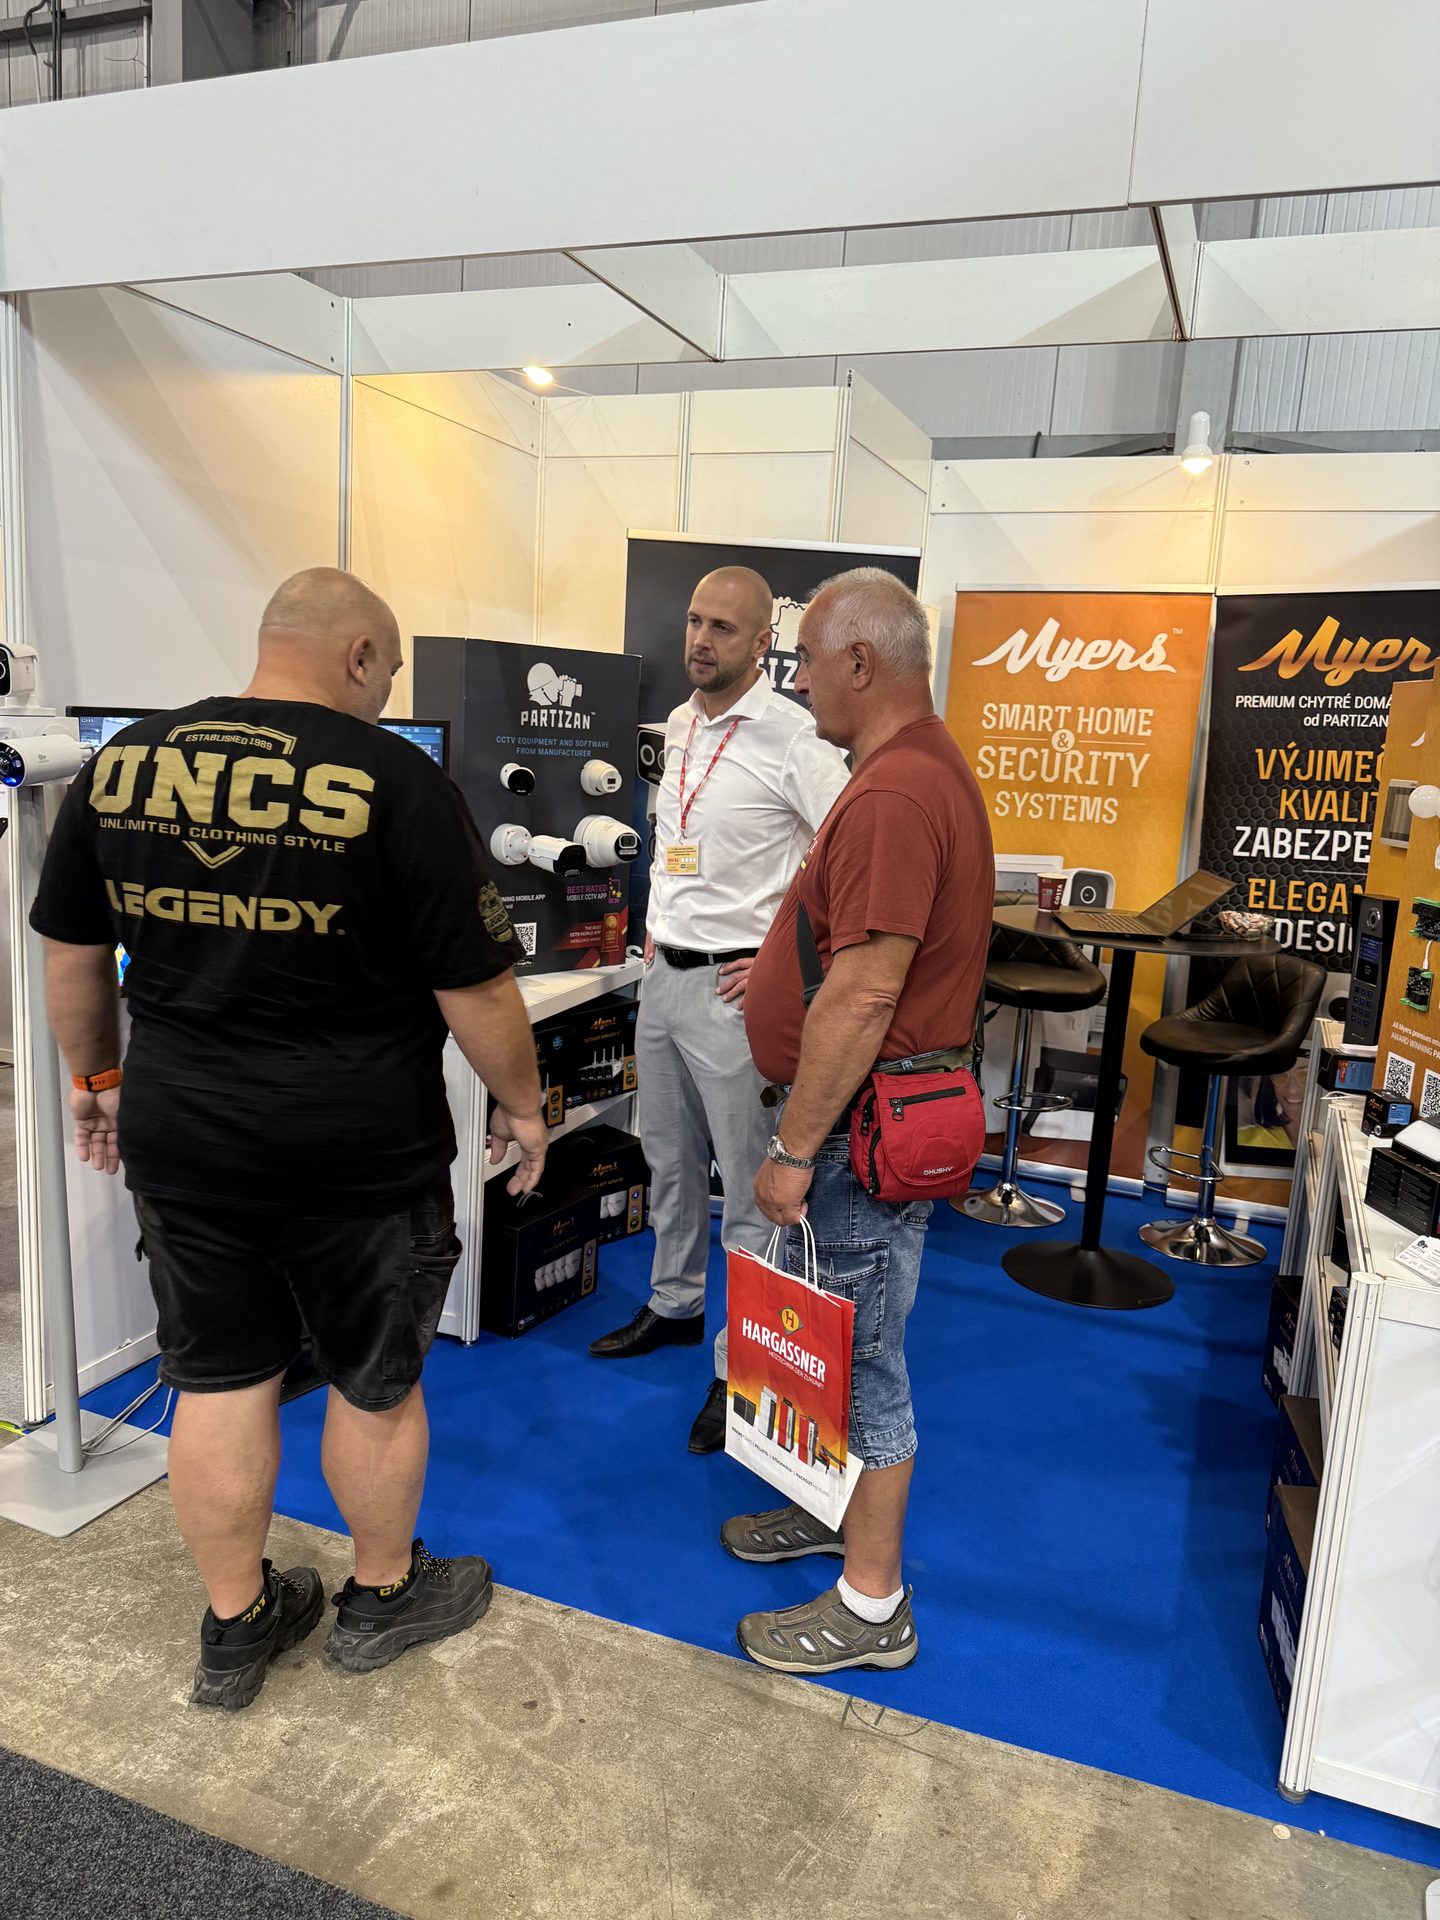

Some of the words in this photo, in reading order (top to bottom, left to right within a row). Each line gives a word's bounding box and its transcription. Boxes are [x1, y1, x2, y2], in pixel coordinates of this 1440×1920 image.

[972, 617, 1176, 682] Myers
[1235, 695, 1295, 709] PREMIUM
[1298, 693, 1351, 709] CHYTRÉ
[520, 709, 591, 729] PARTIZAN
[981, 702, 1072, 732] SMART
[1076, 706, 1154, 737] HOME
[1303, 713, 1320, 727] od
[1323, 714, 1389, 728] PARTIZAN
[185, 733, 247, 746] ESTABLISHED
[249, 737, 272, 751] 1989
[496, 736, 515, 744] CCTV
[518, 737, 557, 746] EQUIPMENT
[559, 739, 573, 747] AND
[575, 739, 610, 749] SOFTWARE
[516, 747, 536, 755] FROM
[538, 747, 592, 757] MANUFACTURER
[976, 745, 1151, 788] SECURITY
[89, 745, 375, 838] UNCS
[994, 790, 1119, 825] SYSTEMS
[99, 817, 180, 835] UNLIMITED
[189, 827, 277, 845] CLOTHING
[284, 835, 345, 853] STYLE
[1232, 825, 1373, 864] ZABEZPE
[516, 894, 535, 902] MOBILE
[535, 893, 546, 901] APP
[567, 885, 584, 894] BEST
[585, 884, 608, 893] RATED
[105, 879, 343, 934] LEGENDY
[1273, 917, 1354, 954] DESI
[785, 1310, 794, 1328] H
[742, 1317, 825, 1382] HARGASSNER
[360, 1622, 375, 1631] CAT
